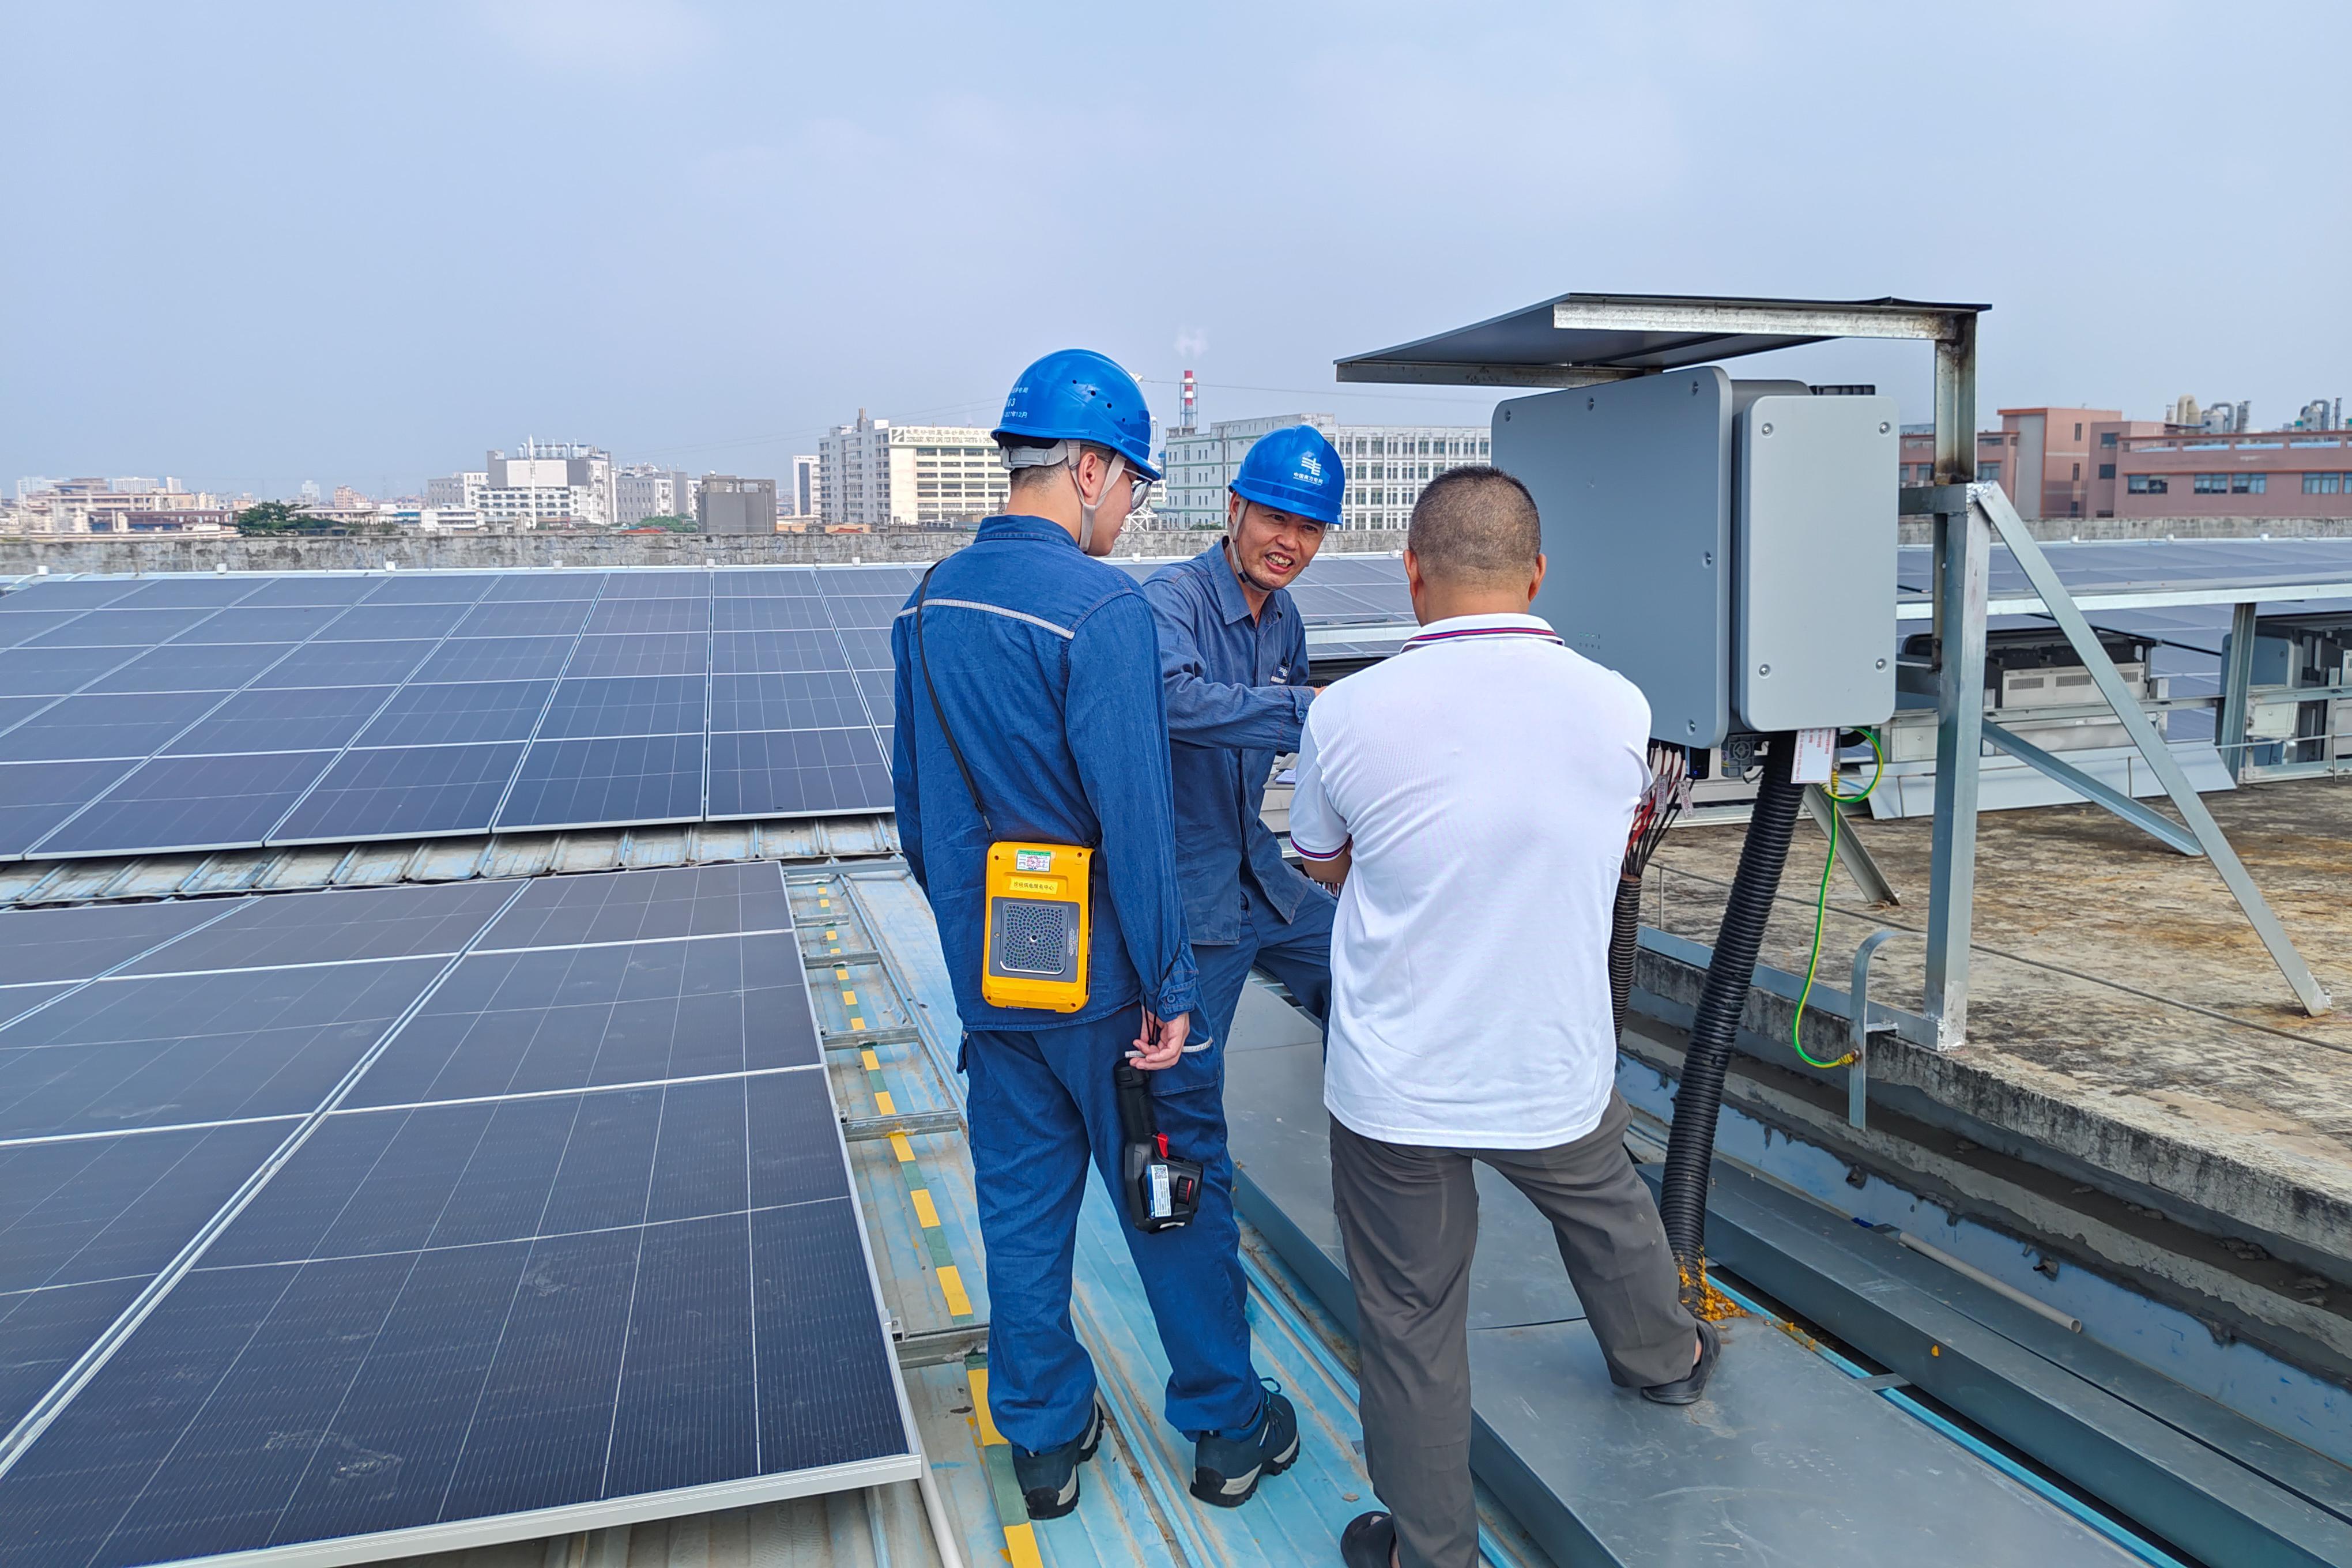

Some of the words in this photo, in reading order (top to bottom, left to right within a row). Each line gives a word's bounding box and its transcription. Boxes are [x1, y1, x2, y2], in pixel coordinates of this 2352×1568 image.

[1294, 472, 1323, 485] 中国南方电网
